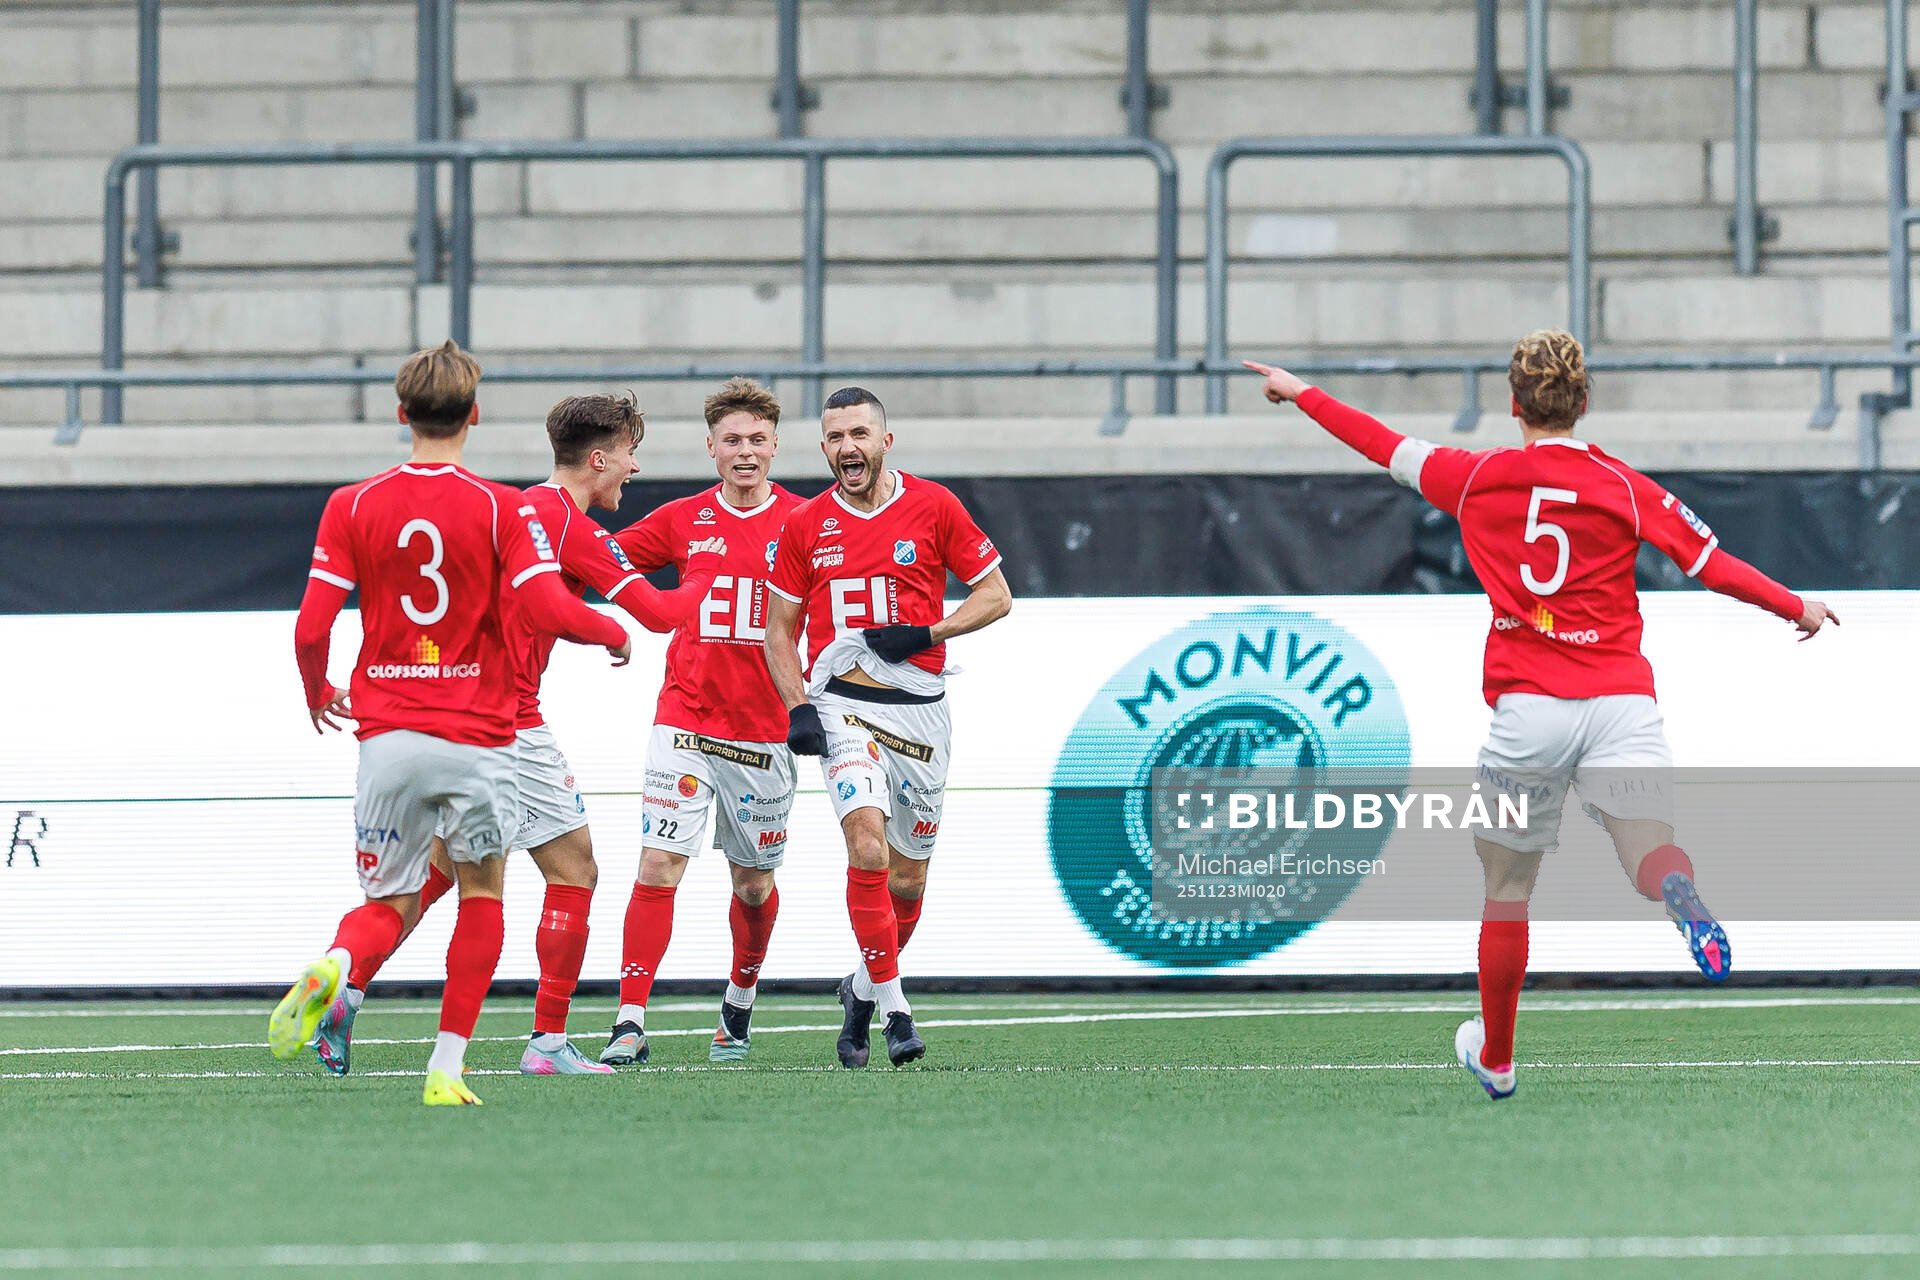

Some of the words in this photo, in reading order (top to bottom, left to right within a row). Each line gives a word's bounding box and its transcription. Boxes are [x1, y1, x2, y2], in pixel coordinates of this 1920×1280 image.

[1519, 486, 1578, 596] 5
[397, 518, 449, 625] 3
[1558, 629, 1600, 645] BYGG
[367, 664, 440, 679] OLOFSSON
[442, 663, 481, 679] BYGG
[1115, 627, 1373, 728] MONVIR
[674, 734, 699, 749] XL
[700, 741, 740, 760] NORRBY
[740, 752, 760, 765] TRÄ
[1479, 763, 1551, 799] INSECTA
[657, 818, 678, 840] 22
[752, 814, 776, 823] Brink
[7, 810, 47, 867] R
